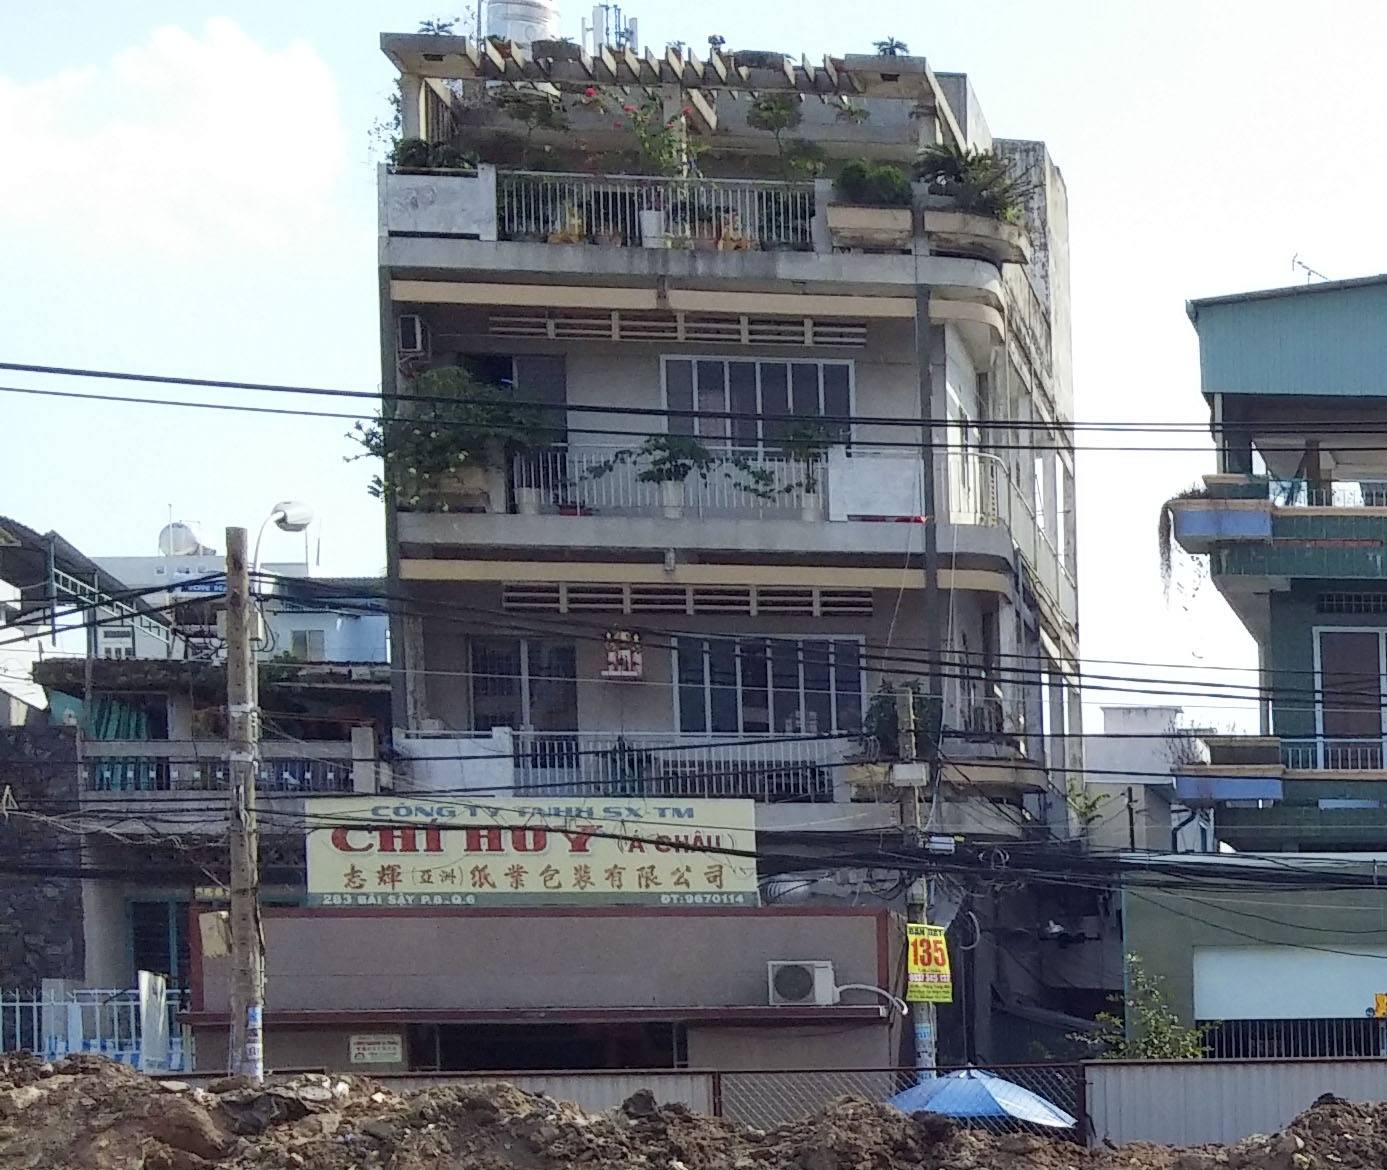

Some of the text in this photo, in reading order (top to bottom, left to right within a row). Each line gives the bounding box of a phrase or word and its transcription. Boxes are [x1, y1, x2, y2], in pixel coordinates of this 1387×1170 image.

[371, 802, 456, 818] CÔNG
[465, 806, 500, 818] TY
[602, 807, 644, 819] SX
[652, 806, 695, 819] TM
[463, 823, 604, 853] HUY
[910, 937, 947, 967] 135
